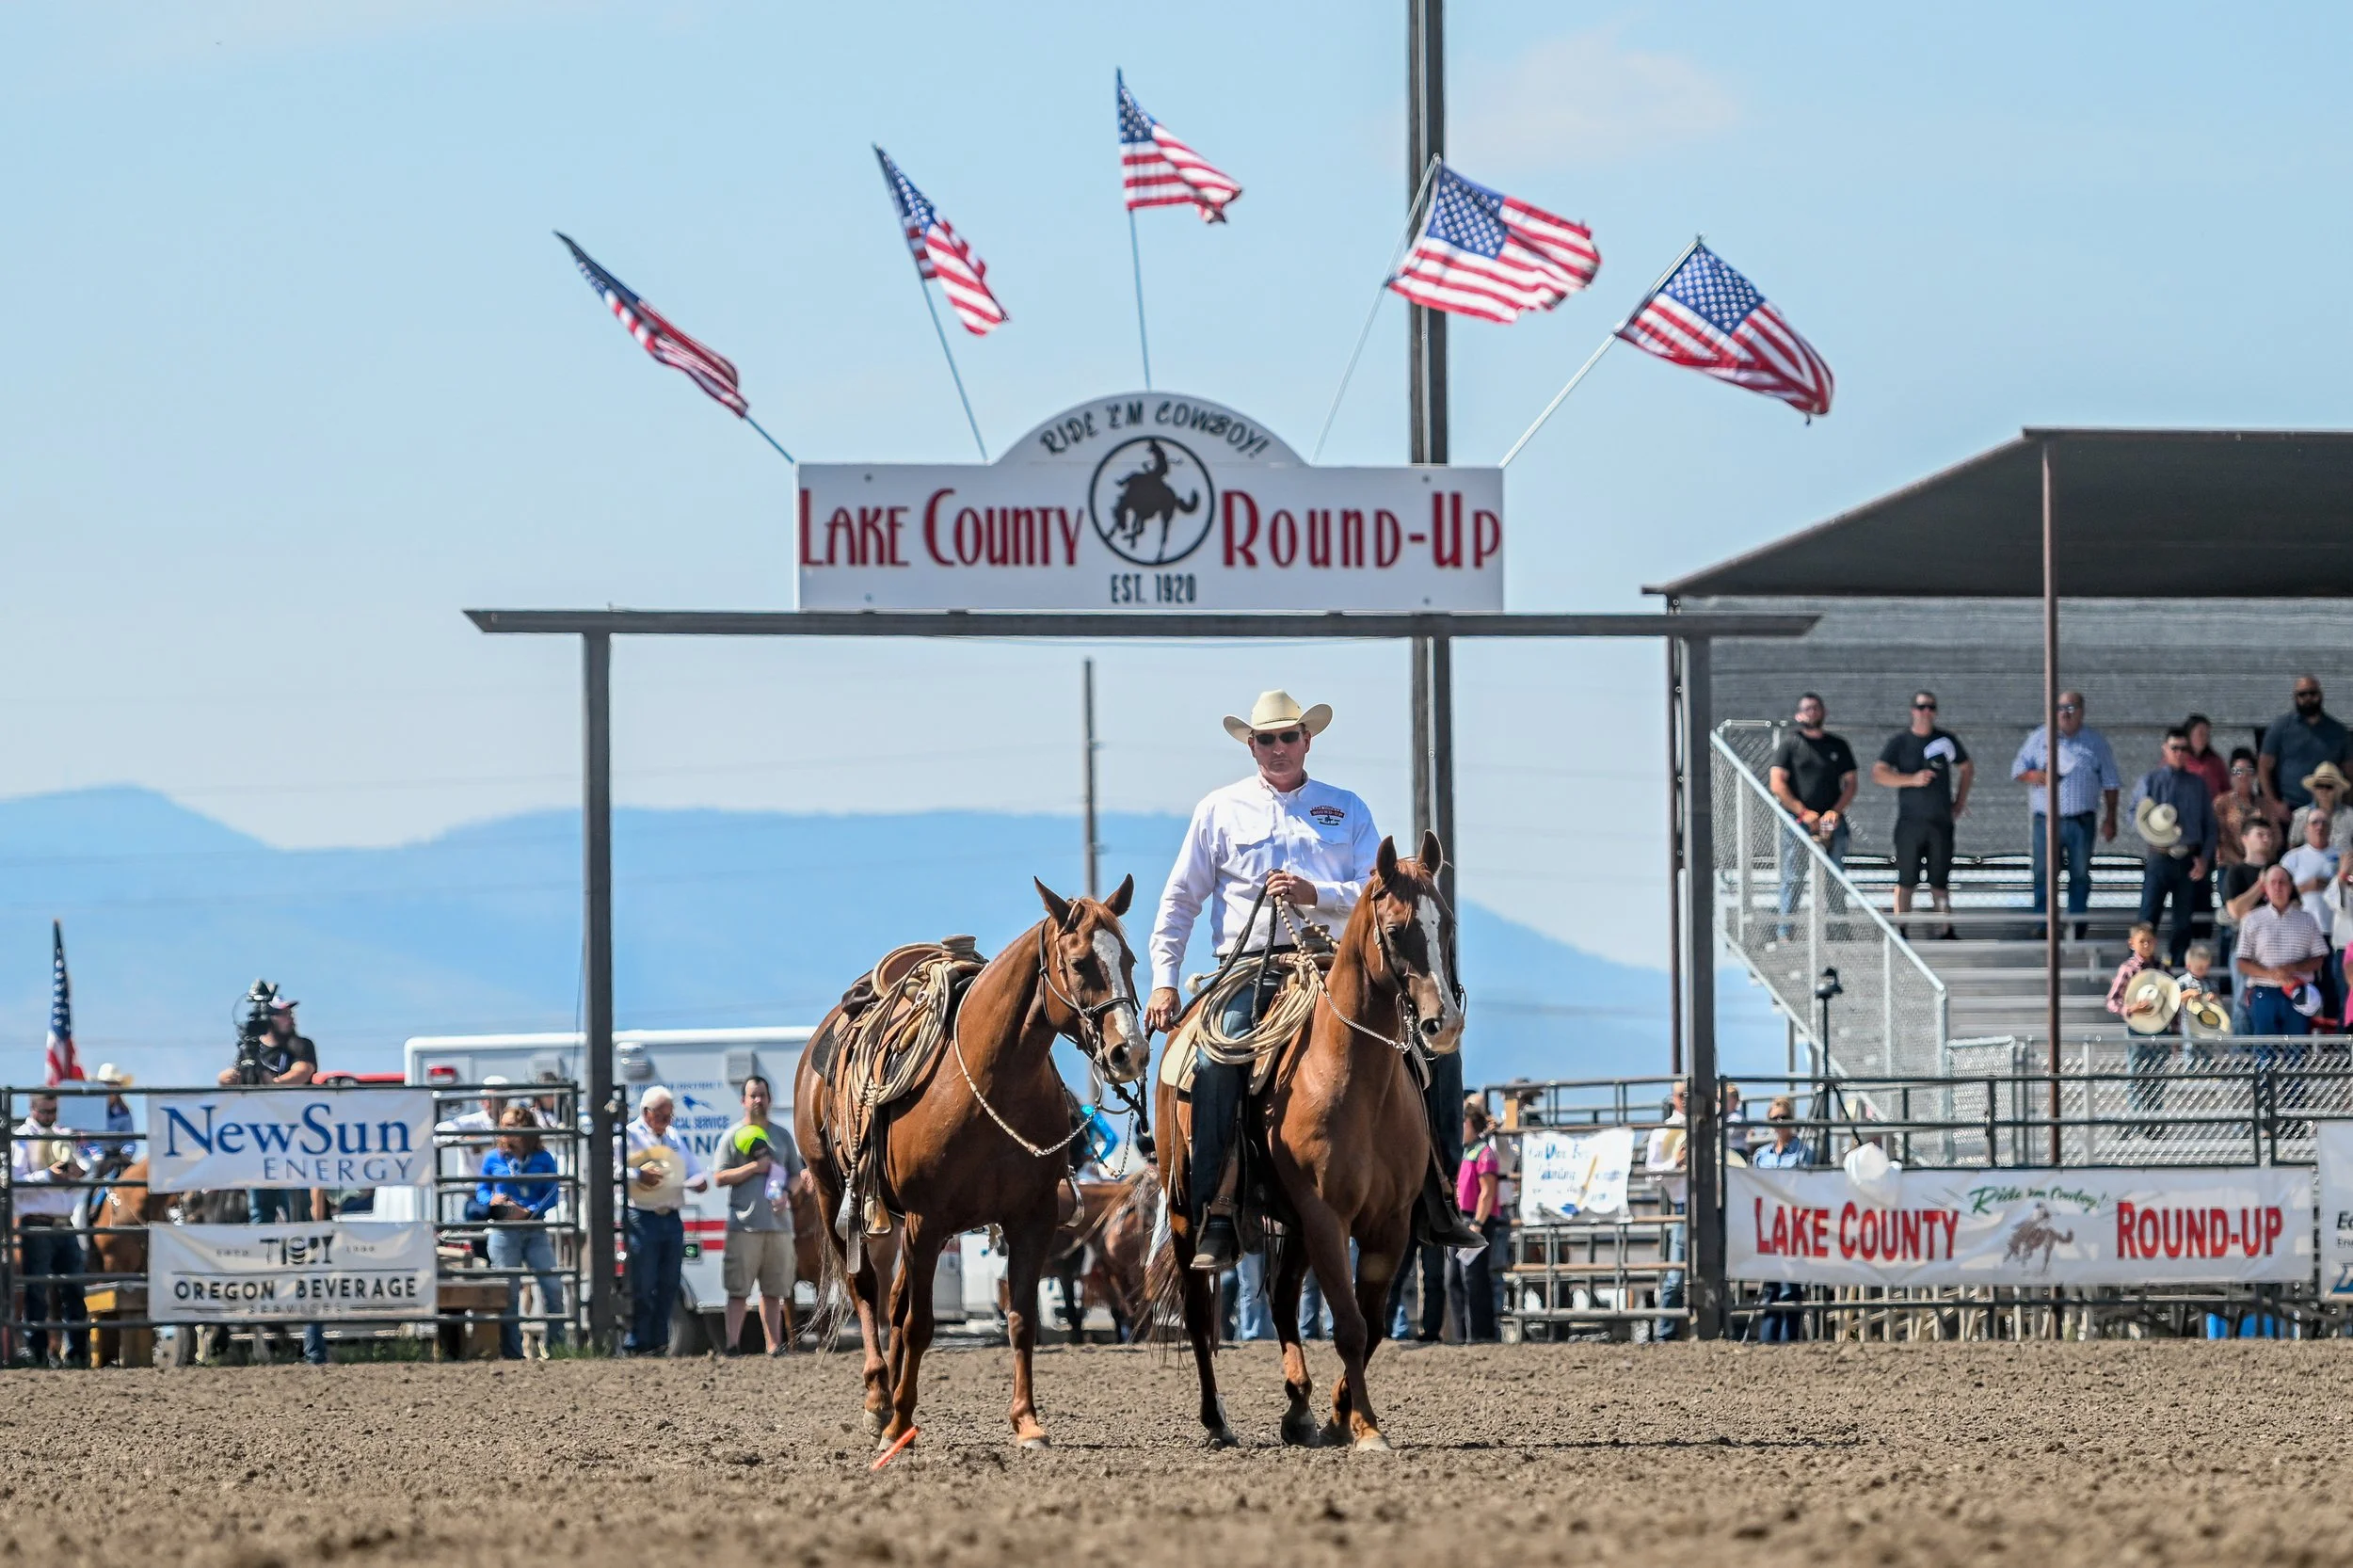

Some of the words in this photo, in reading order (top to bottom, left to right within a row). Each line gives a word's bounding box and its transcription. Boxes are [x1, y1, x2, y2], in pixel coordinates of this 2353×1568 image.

[1040, 410, 1099, 456] RIDE
[1155, 400, 1270, 459] COWBOY!
[798, 488, 910, 568] LAKE
[923, 488, 1083, 568] COUNTY
[1223, 489, 1502, 569] ROUND-UP
[1111, 572, 1147, 604] EST.
[1156, 572, 1197, 604] 1920
[160, 1103, 412, 1156] NewSun
[263, 1157, 414, 1182] ENERGY
[1754, 1196, 1829, 1258] LAKE
[1839, 1199, 1961, 1262] COUNTY
[2117, 1201, 2283, 1259] ROUND-UP
[173, 1280, 276, 1301] OREGON
[295, 1276, 417, 1300] BEVERAGE
